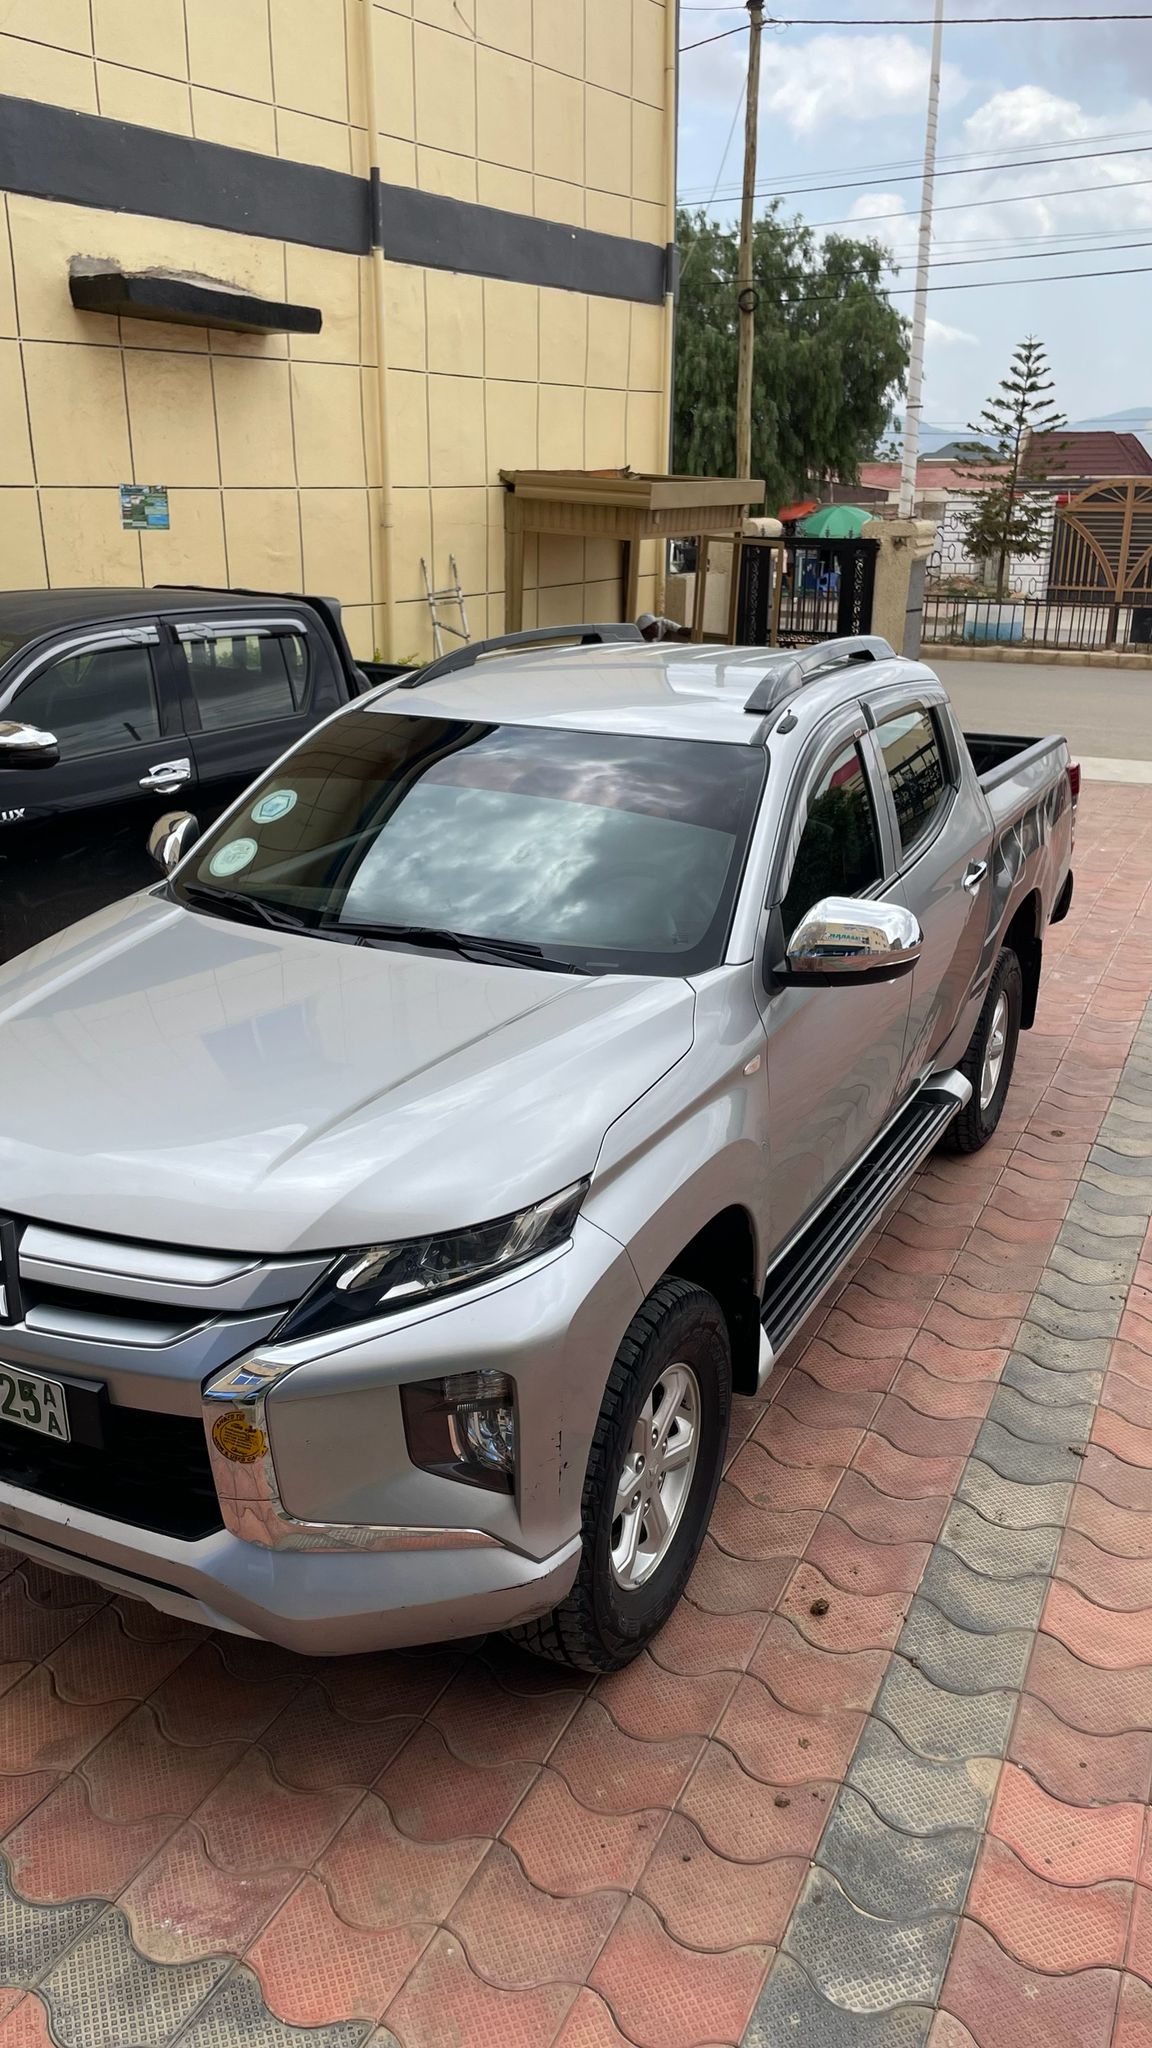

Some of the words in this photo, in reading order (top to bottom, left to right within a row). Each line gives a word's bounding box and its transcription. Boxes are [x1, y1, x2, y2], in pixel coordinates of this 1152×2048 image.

[0, 808, 25, 822] UX
[0, 1373, 41, 1423] 25
[44, 1383, 56, 1408] A
[48, 1411, 62, 1435] A
